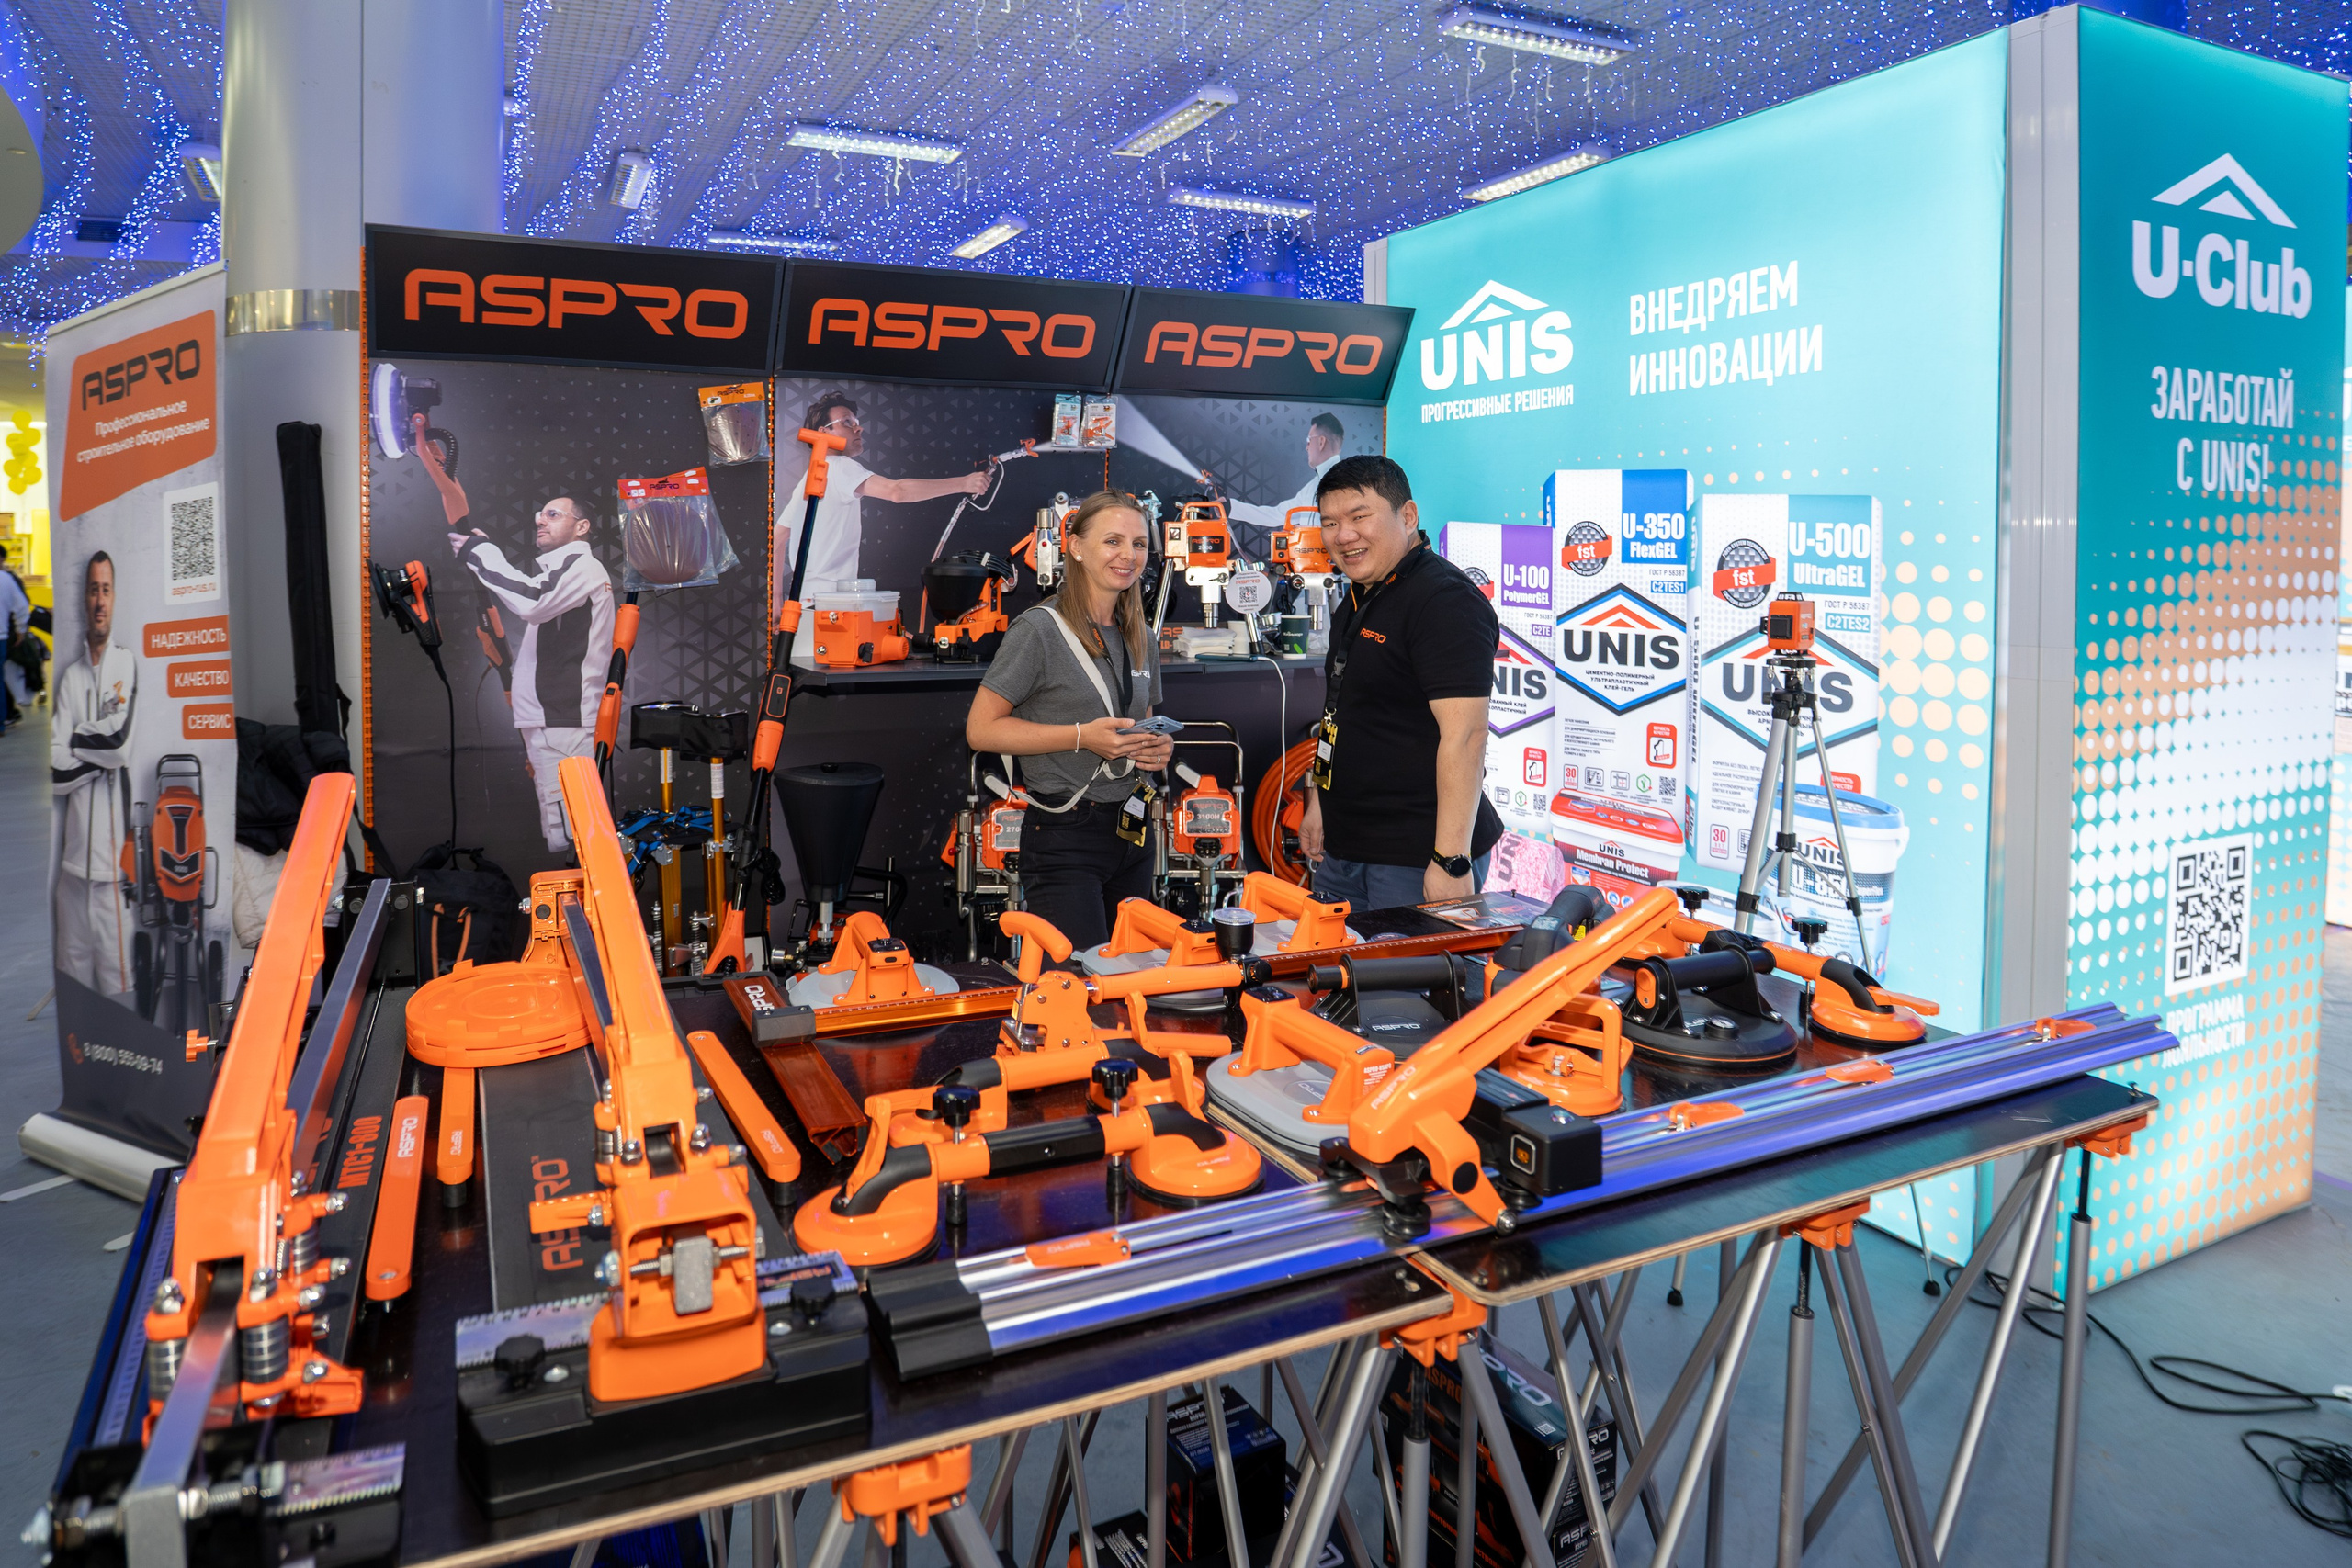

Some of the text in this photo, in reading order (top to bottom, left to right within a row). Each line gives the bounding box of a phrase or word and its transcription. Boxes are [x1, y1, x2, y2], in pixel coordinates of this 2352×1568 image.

[2132, 220, 2312, 319] U-Club
[404, 267, 749, 340] ASPRO
[1629, 260, 1799, 336] ВНЕДРЯЕМ
[808, 297, 1097, 359] ASPRO
[1144, 321, 1384, 376] ASPRO
[1420, 310, 1574, 391] UNIS
[1629, 324, 1823, 396] ИННОВАЦИИ
[82, 339, 200, 411] ASPRO
[1421, 384, 1574, 423] ПРОГРЕССИВНЫЕ РЕШЕНИЯ
[2151, 365, 2295, 429] ЗАРАБОТАЙ
[95, 400, 187, 438] Профессиональное
[135, 417, 210, 446] оборудование
[2202, 438, 2270, 493] UNIS!
[1623, 513, 1685, 540] U-350
[1788, 521, 1871, 558] U-500
[1577, 545, 1596, 559] fst
[1630, 542, 1678, 558] FlexGEL
[1503, 563, 1550, 590] U-100
[1652, 581, 1684, 592] C2TES1
[1732, 569, 1756, 587] fst
[1793, 562, 1866, 588] UltraGEL
[1503, 590, 1550, 605] PolymerGEL
[1824, 600, 1841, 608] ГОСТ
[1360, 627, 1387, 644] ASPRO
[1532, 625, 1551, 636] C2TE
[1826, 615, 1870, 631] C2TES2
[151, 627, 227, 649] НАДЕЖНОСТЬ
[1564, 629, 1679, 670] UNIS
[174, 670, 230, 688] КАЧЕСТВО
[1492, 665, 1547, 700] NIS
[187, 714, 232, 729] СЕРВИС
[1566, 767, 1577, 778] 30
[1599, 843, 1625, 857] UNIS
[1713, 828, 1727, 844] 30
[1576, 849, 1614, 869] Membran
[1615, 859, 1649, 879] Protect
[1372, 1022, 1421, 1032] ASPRO
[2165, 993, 2245, 1037] ПРОГРАММА
[337, 1115, 383, 1189] MTC1-800
[397, 1117, 419, 1158] ASPRO
